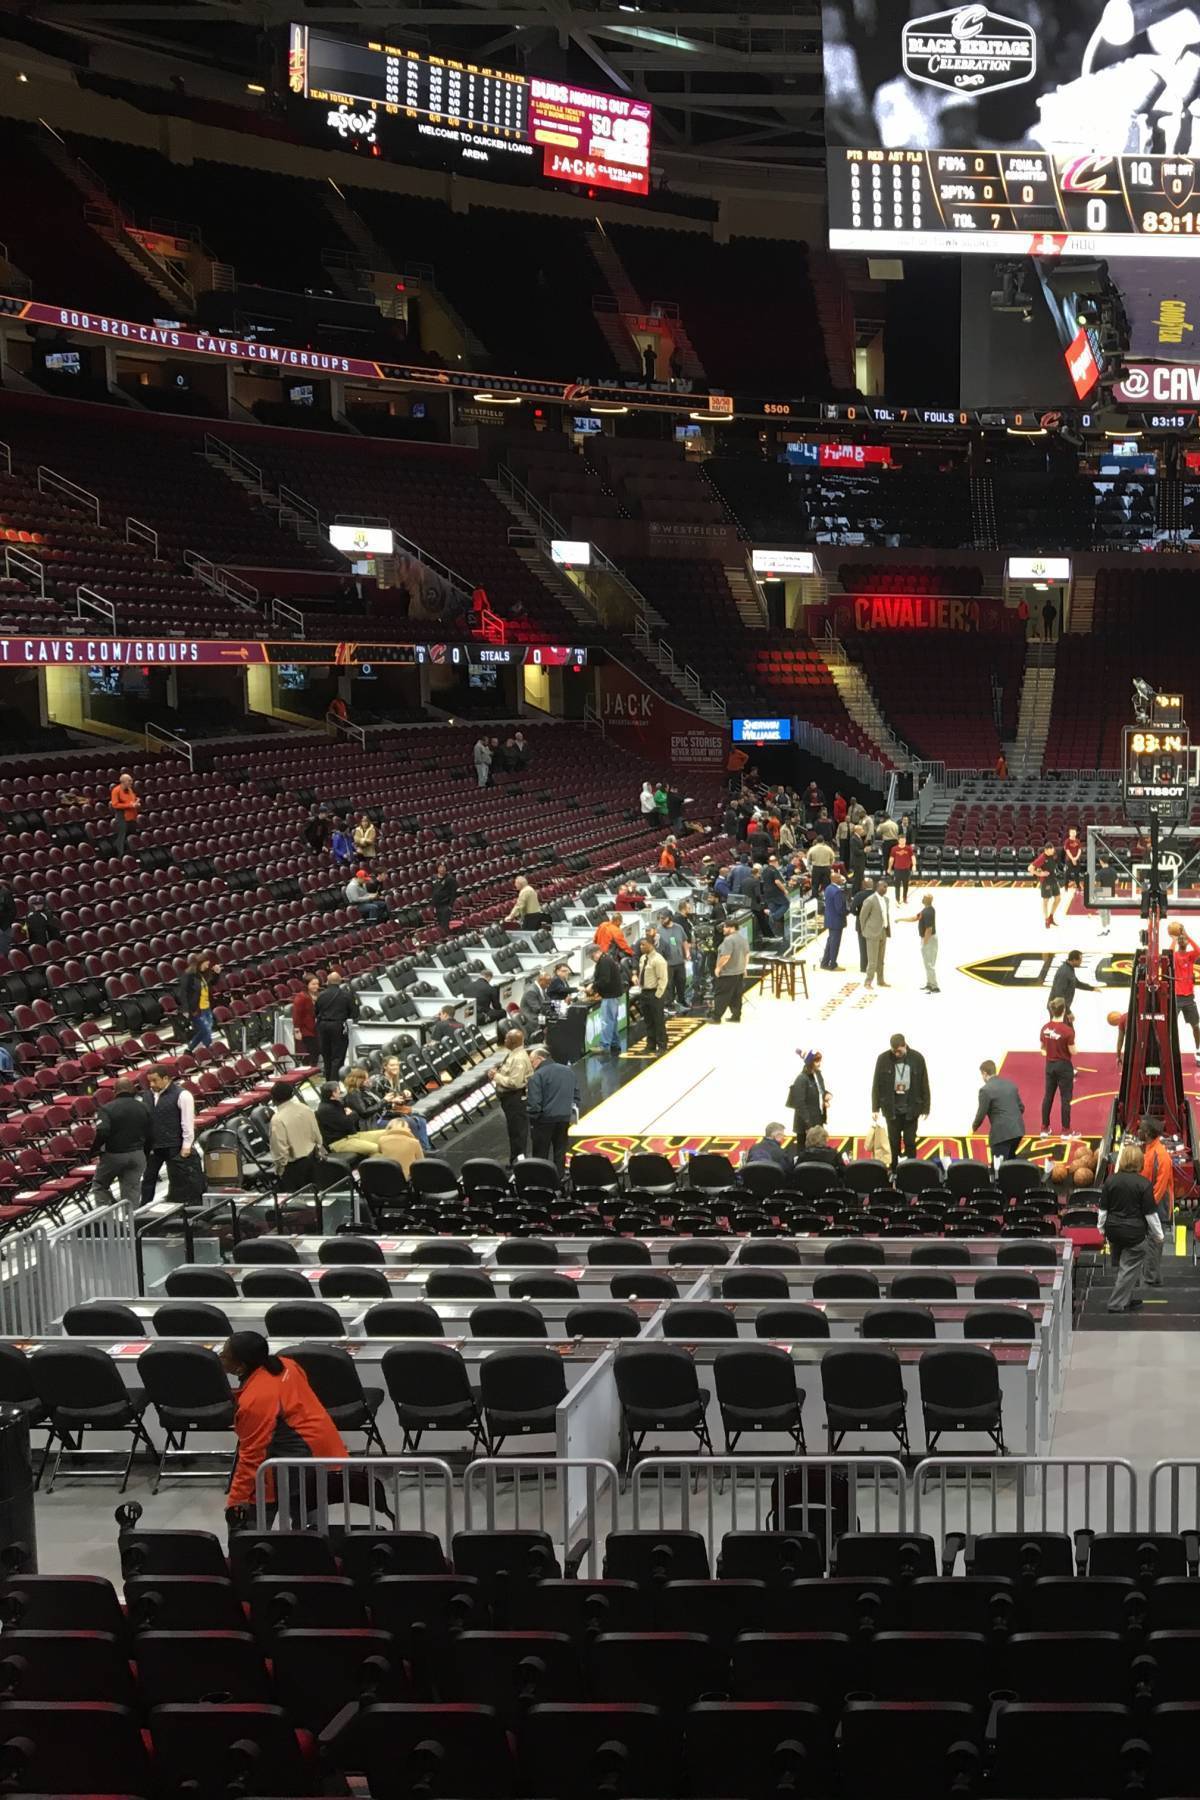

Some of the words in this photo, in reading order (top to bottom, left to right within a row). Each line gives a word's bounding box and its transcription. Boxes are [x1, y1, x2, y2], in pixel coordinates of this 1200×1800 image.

[908, 38, 957, 54] BLACK
[960, 39, 1029, 56] HERITAGE
[310, 89, 328, 100] TEAM
[330, 93, 354, 105] TOTALS
[569, 90, 608, 111] NIGHTS
[608, 99, 630, 116] OUT
[418, 124, 459, 140] WELCOME
[460, 133, 472, 143] TO
[473, 134, 507, 150] QUICKEN
[508, 142, 533, 155] LOANS
[462, 148, 488, 161] ARENA
[888, 151, 904, 162] AST
[974, 158, 984, 172] 0
[1130, 162, 1154, 186] 1Q
[983, 185, 993, 199] 0
[1172, 178, 1182, 194] 0
[1022, 185, 1034, 203] 0
[991, 214, 1000, 229] 7
[1087, 199, 1107, 231] 0
[60, 311, 180, 346] 800-820-CAVS
[196, 337, 349, 371] CAVS.COM/GROUPS
[764, 403, 790, 414] $500
[847, 408, 856, 419] 0
[874, 409, 895, 421] TOL:
[900, 410, 907, 421] 7
[924, 412, 955, 423] FOULS
[960, 412, 967, 424] 0
[1015, 414, 1022, 425] 0
[1082, 415, 1090, 427] 0
[1152, 416, 1184, 427] 83:15
[661, 525, 727, 536] WESTFIELD
[25, 641, 198, 664] CAVS.COM/GROUPS
[418, 653, 424, 663] 0
[452, 648, 459, 663] 0
[480, 650, 510, 662] STEALS
[533, 649, 541, 663] 0
[577, 655, 583, 664] 0
[671, 736, 688, 747] EPIC
[690, 736, 722, 748] STORIES
[1145, 787, 1184, 796] TISSOT
